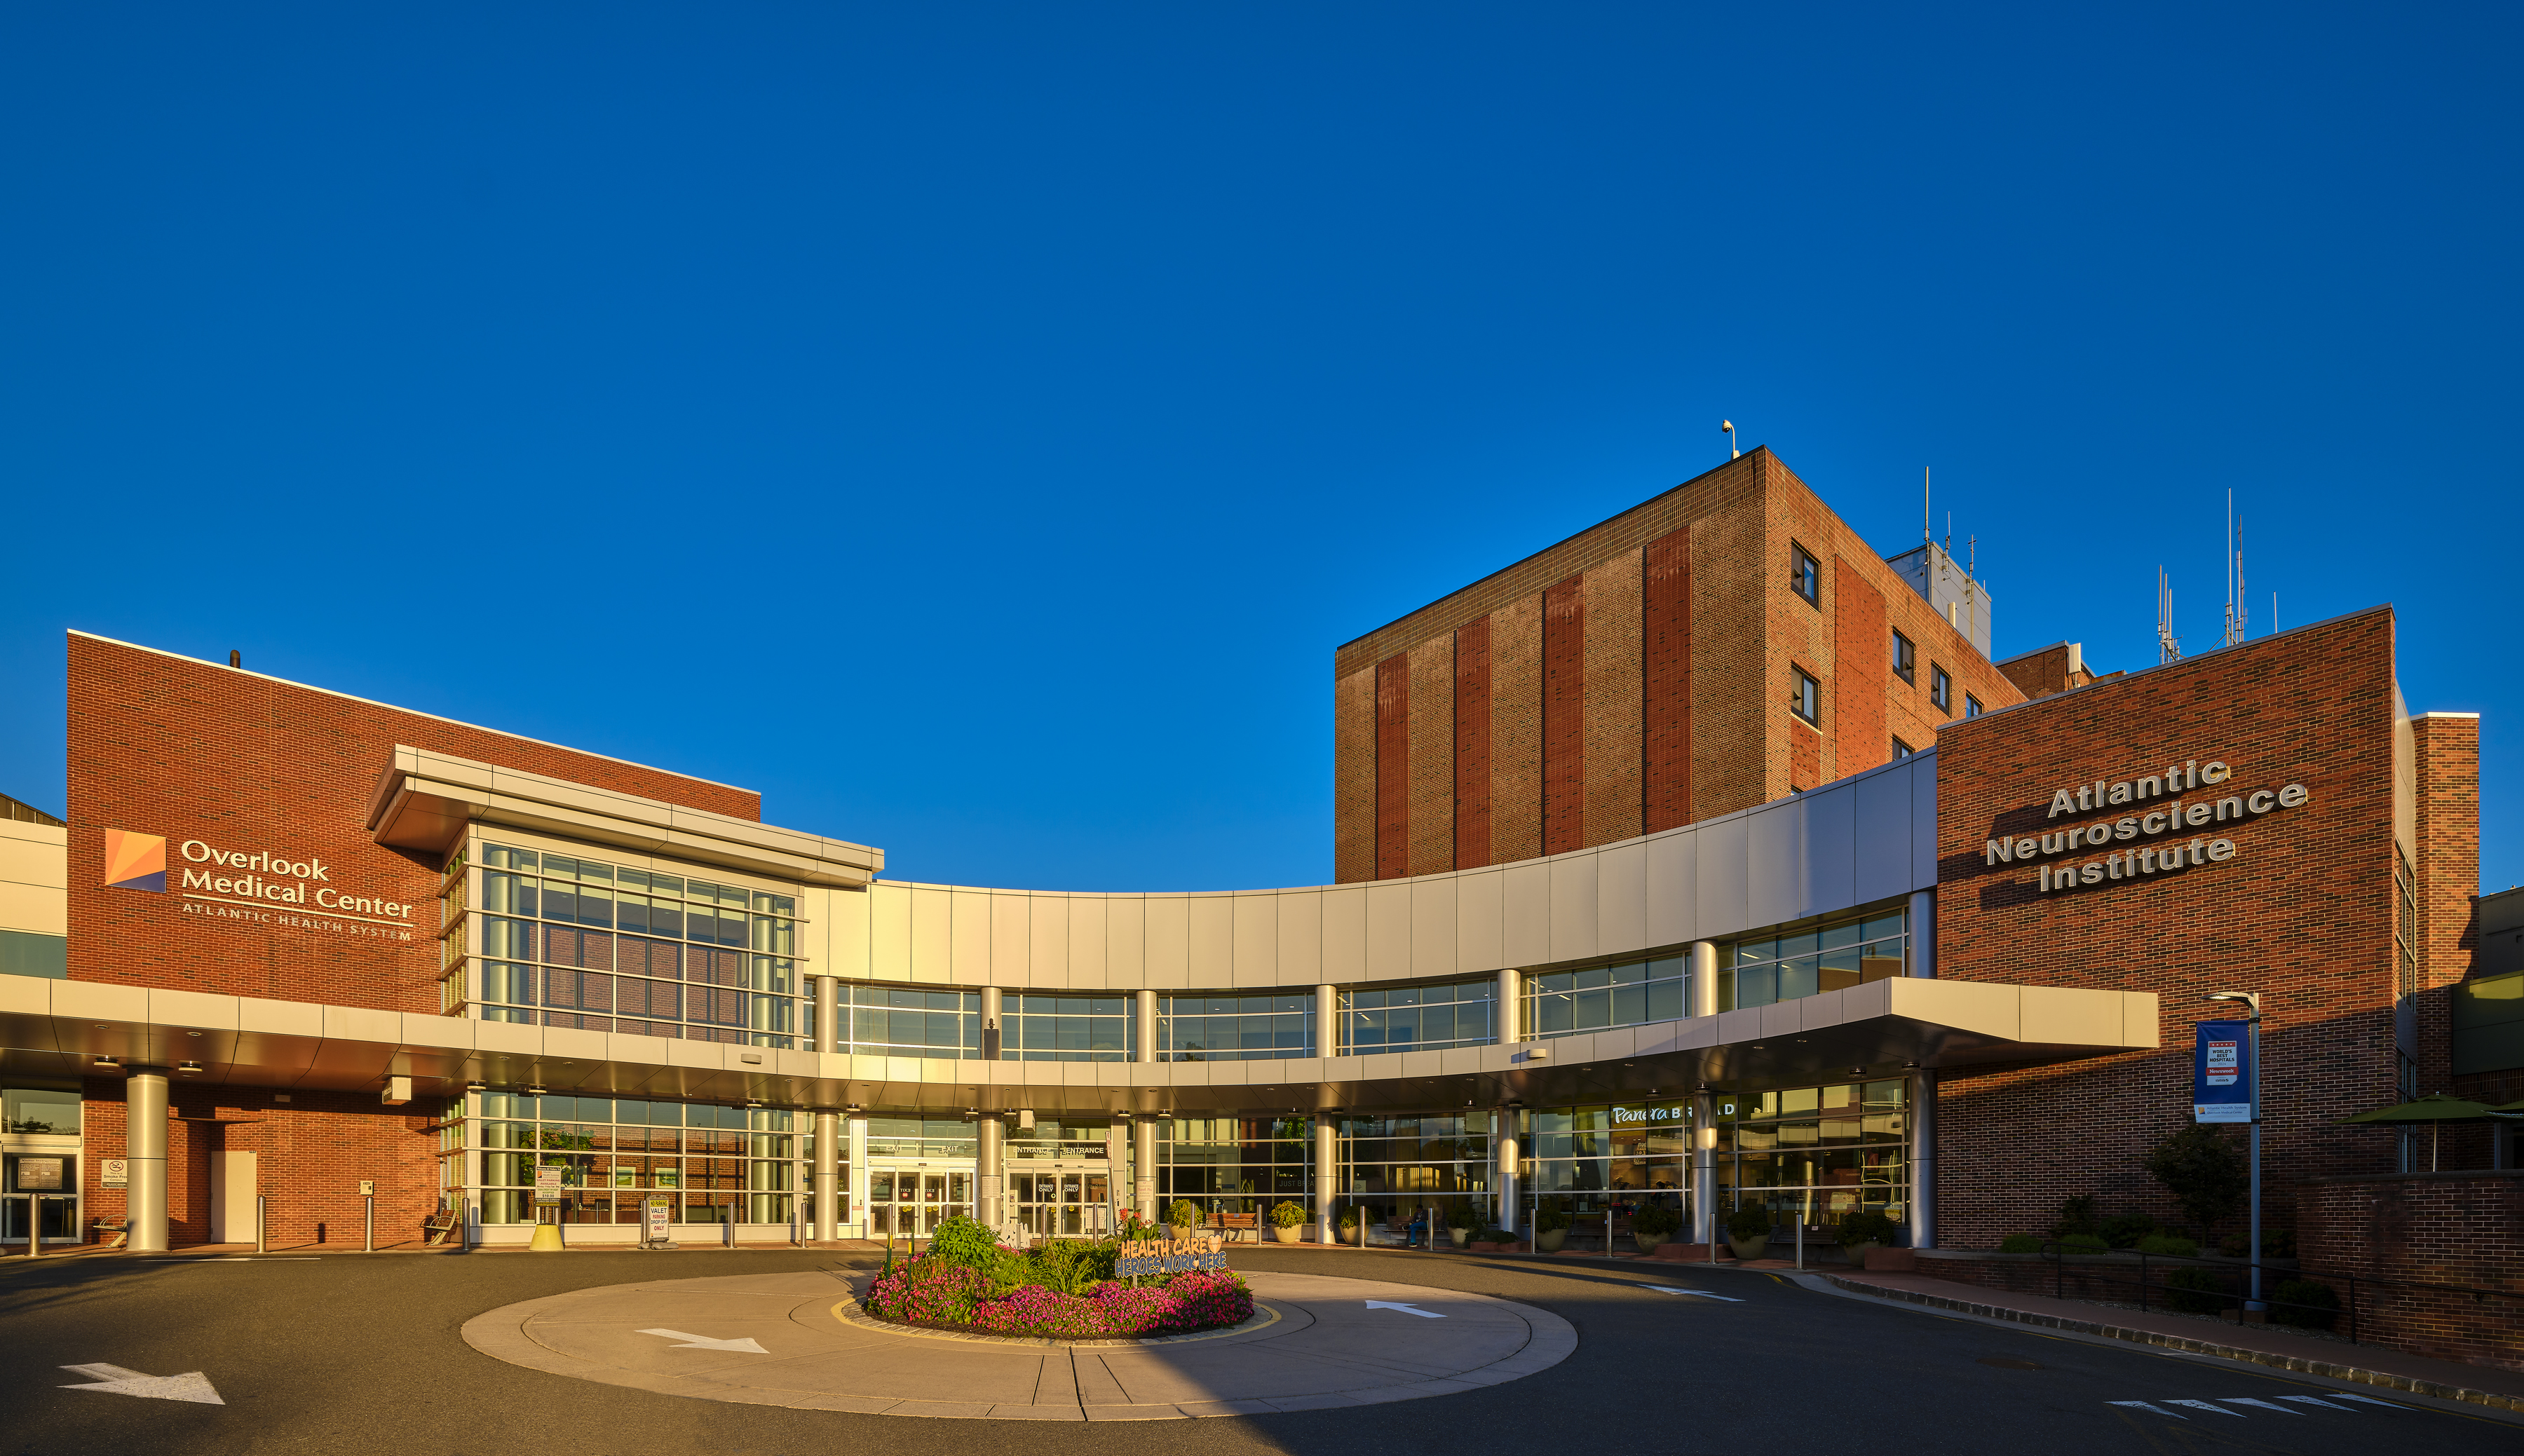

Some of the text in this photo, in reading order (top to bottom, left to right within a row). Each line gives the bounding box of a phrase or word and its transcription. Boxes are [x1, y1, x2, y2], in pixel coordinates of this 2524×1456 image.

[2047, 759, 2230, 818] Atlantic
[1987, 782, 2307, 866] Neuroscience
[181, 840, 330, 881] Overlook
[2040, 838, 2236, 892] Institute
[182, 868, 412, 918] Medical Center
[182, 903, 410, 941] ATLANTIC HEALTH SYSTEM
[1613, 1103, 1735, 1124] Panera BRD
[1115, 1251, 1227, 1279] HEROES WORK HERE
[1121, 1236, 1207, 1258] HEALTH CARE
